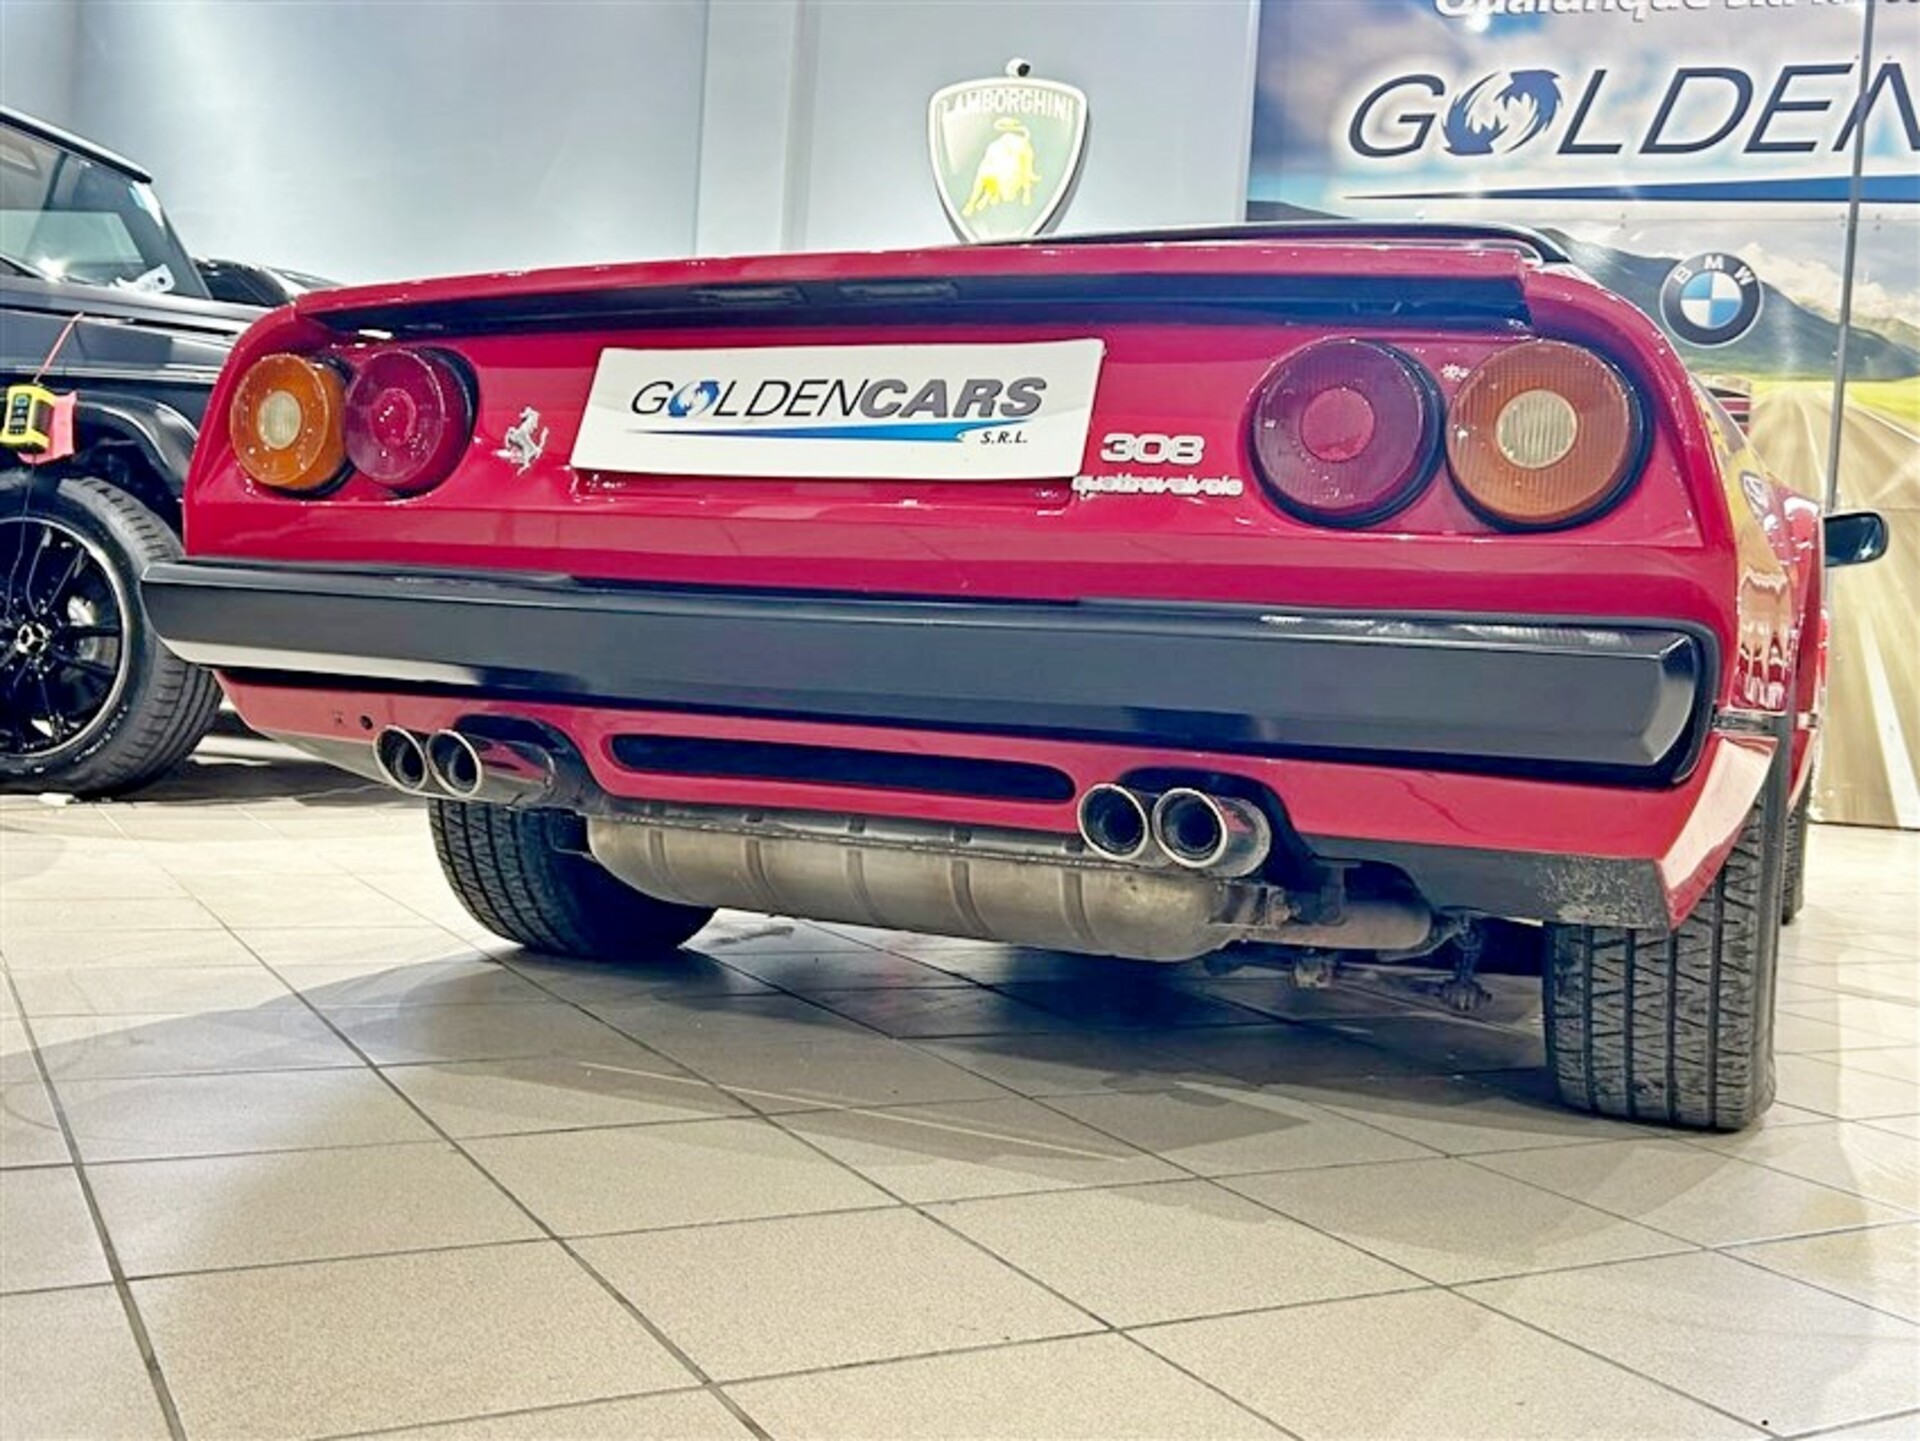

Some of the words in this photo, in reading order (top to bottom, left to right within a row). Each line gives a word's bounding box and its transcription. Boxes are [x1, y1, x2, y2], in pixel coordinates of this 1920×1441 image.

[942, 88, 1074, 122] LAMBORGHINI
[1673, 255, 1754, 286] BMW
[980, 430, 1028, 444] S.R.L.
[1100, 433, 1204, 465] 308
